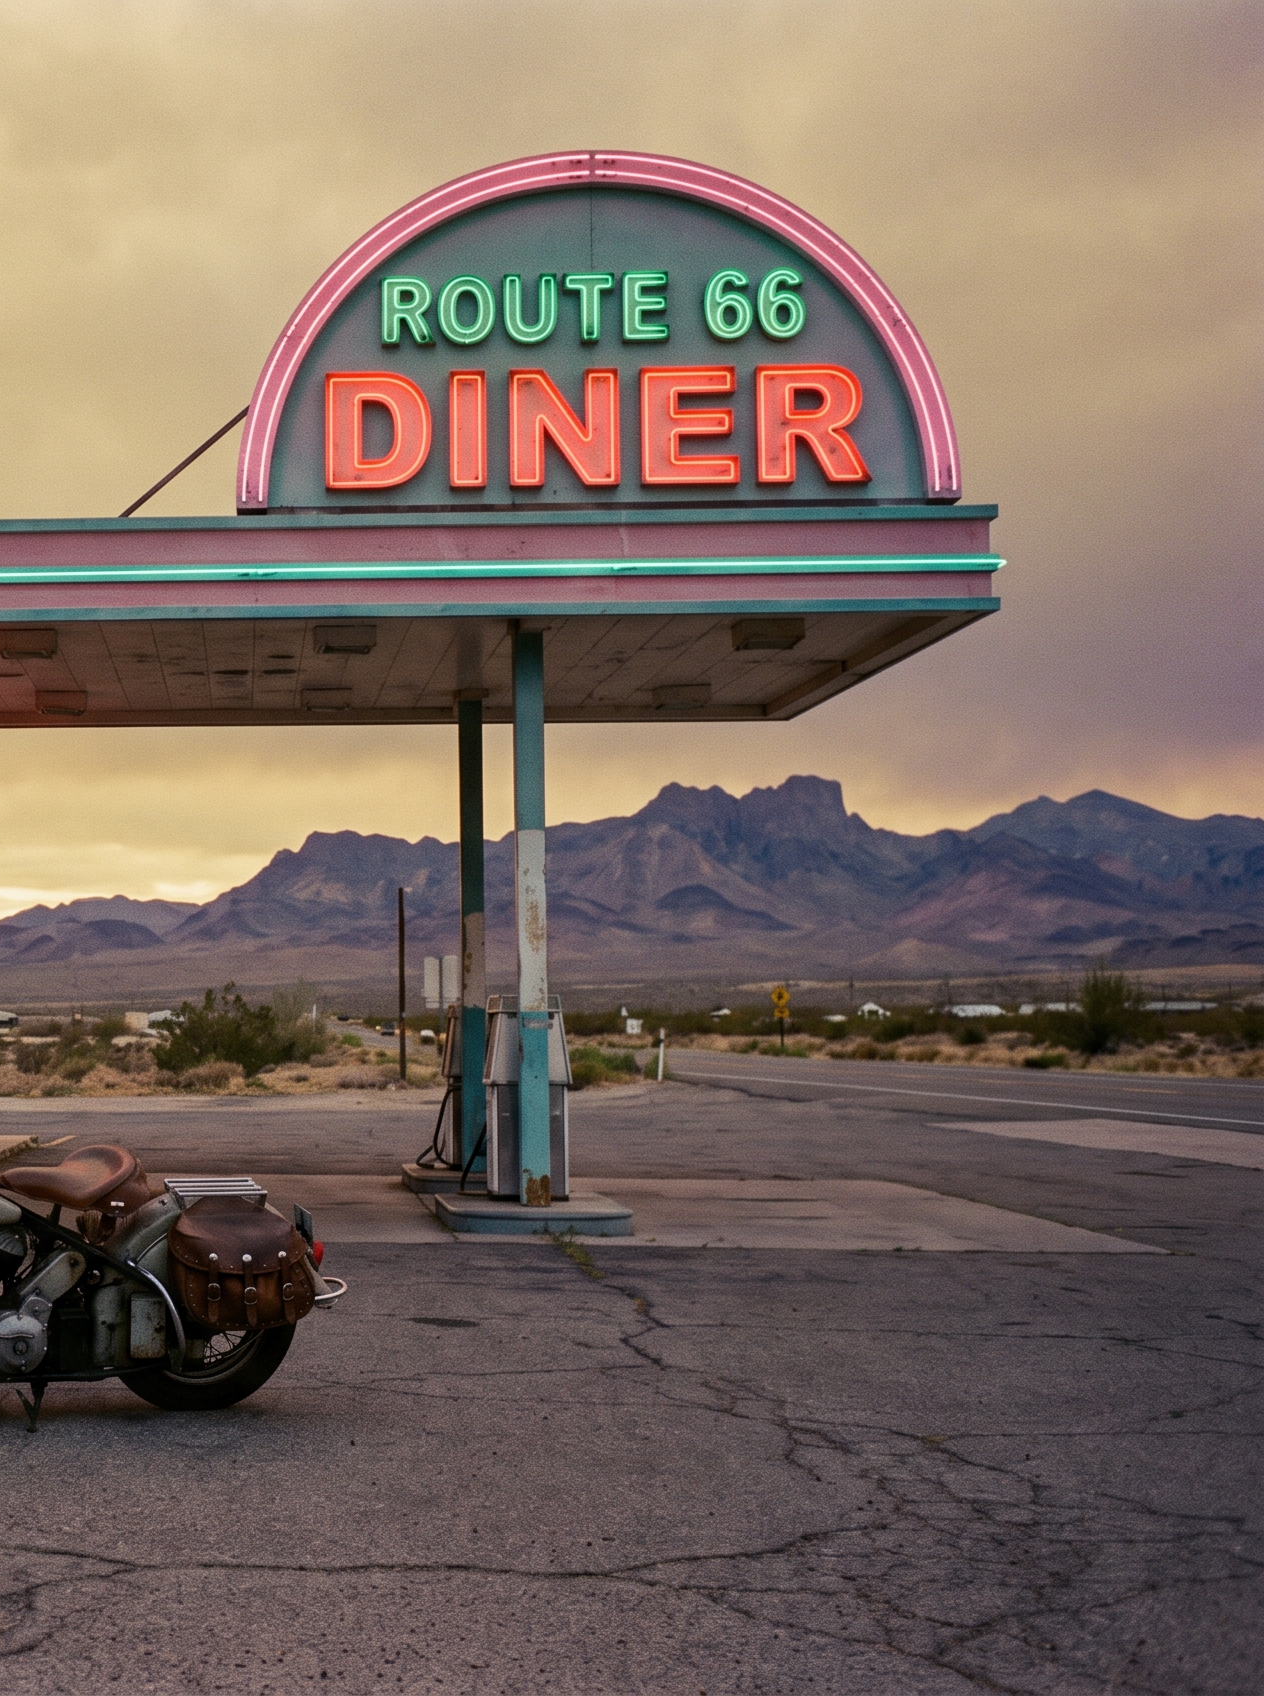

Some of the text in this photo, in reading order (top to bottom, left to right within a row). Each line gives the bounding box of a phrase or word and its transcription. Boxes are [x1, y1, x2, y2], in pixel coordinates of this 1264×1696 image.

[381, 267, 807, 347] ROUTE 66
[324, 364, 872, 490] DINER
